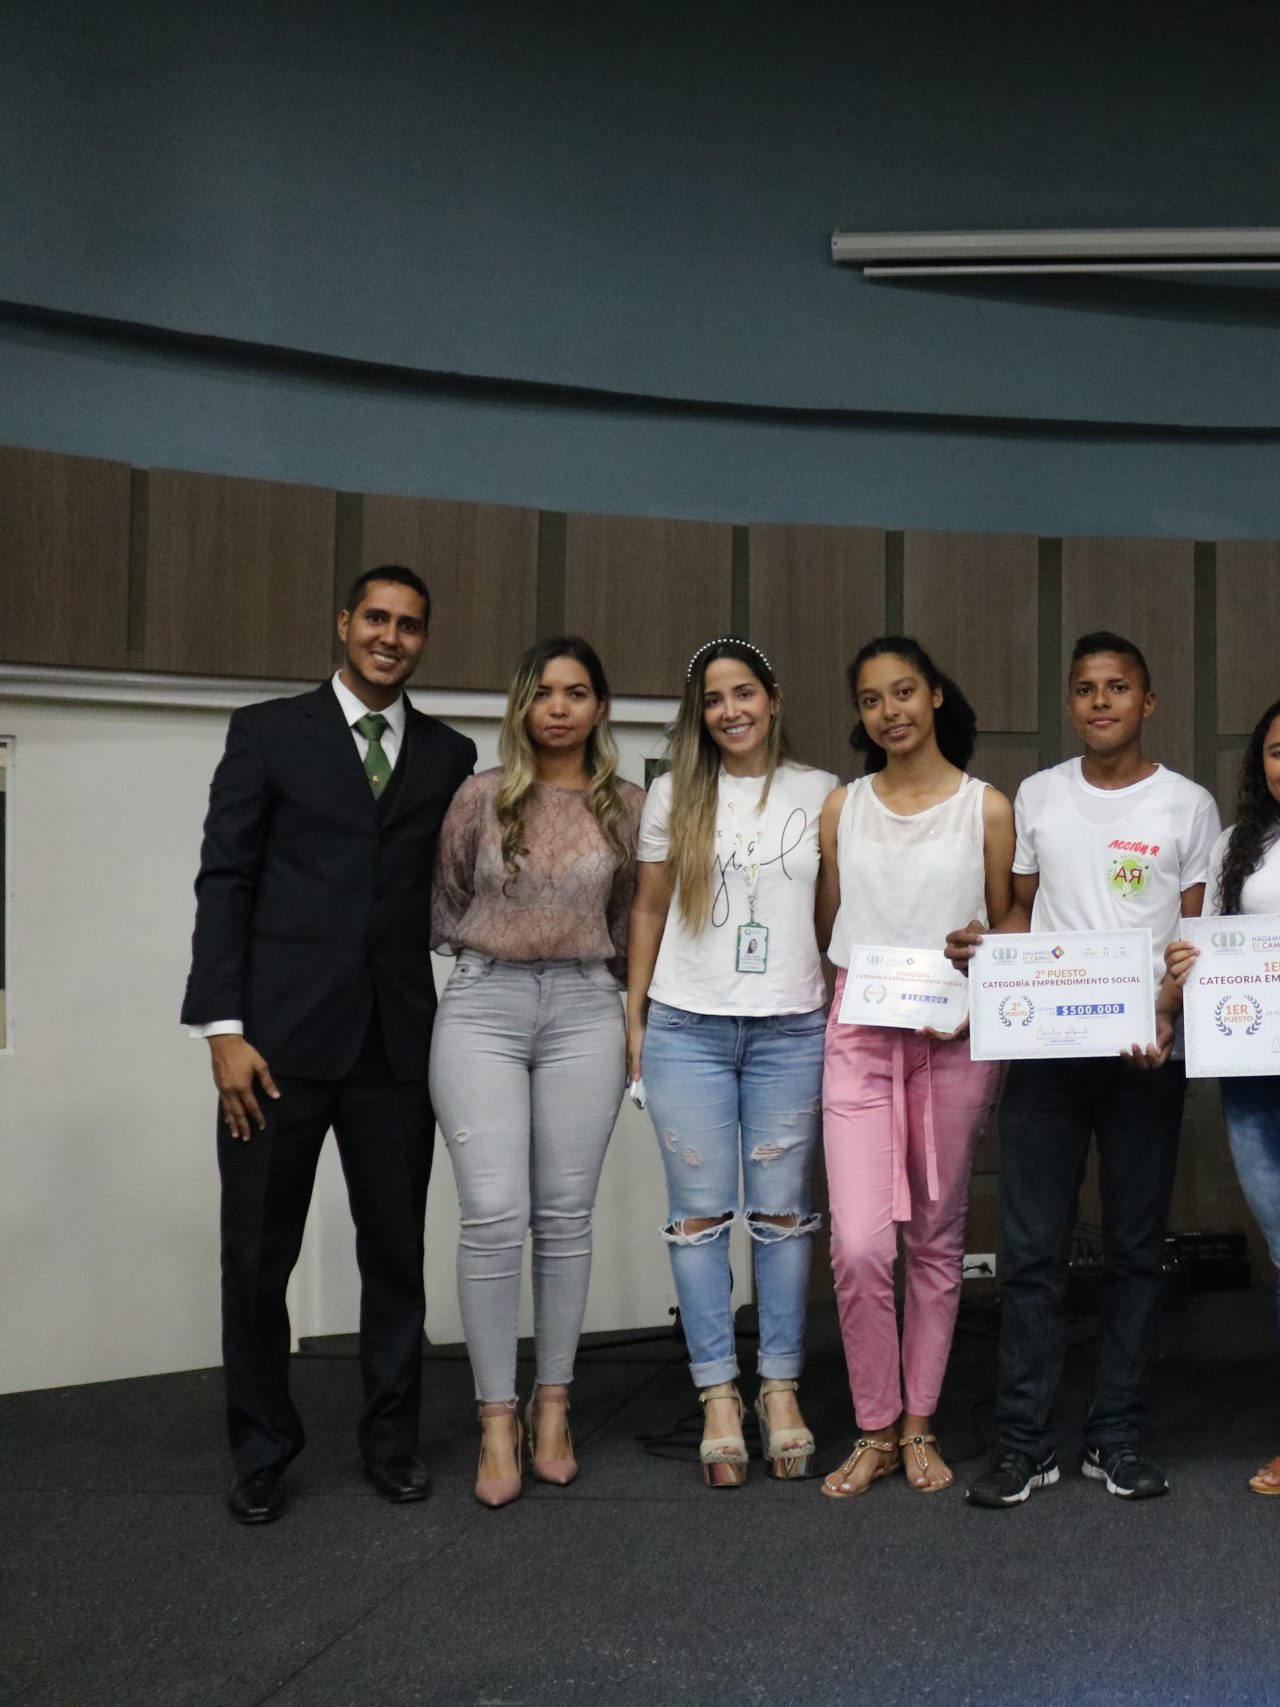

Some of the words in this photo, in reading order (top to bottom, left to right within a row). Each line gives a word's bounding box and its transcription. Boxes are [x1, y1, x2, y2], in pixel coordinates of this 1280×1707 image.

[1047, 968, 1087, 978] PUESTO
[943, 980, 963, 988] SOCIAL
[982, 979, 1030, 988] CATEGORÍA
[1032, 977, 1109, 987] EMPRENDIMIENTO
[1111, 975, 1141, 984] SOCIAL
[1199, 975, 1262, 985] CATEGORIA
[1062, 1004, 1120, 1016] $500.000
[1225, 1004, 1248, 1016] 1ER
[1224, 1015, 1254, 1023] PUESTO
